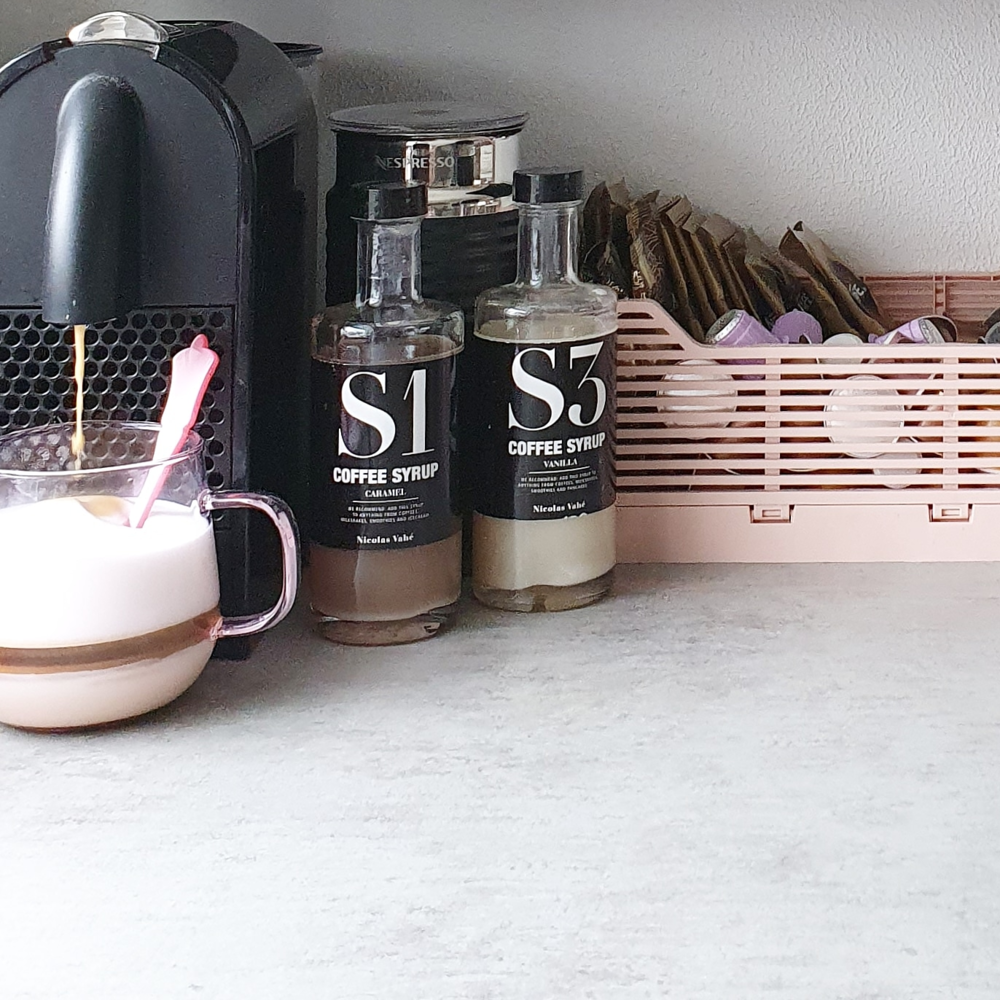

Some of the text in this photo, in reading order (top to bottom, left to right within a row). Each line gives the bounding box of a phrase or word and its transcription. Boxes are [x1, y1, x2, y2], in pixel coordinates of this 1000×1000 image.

[508, 341, 607, 431] S3
[338, 369, 435, 459] S1
[508, 432, 606, 456] COFFEE SYRUP
[543, 458, 578, 469] VANILLA
[333, 462, 439, 485] COFFEE SYRUP
[364, 487, 408, 498] CARAMEL
[532, 500, 586, 513] Nicolas Vahé
[356, 532, 415, 544] Nicolas Vahé
